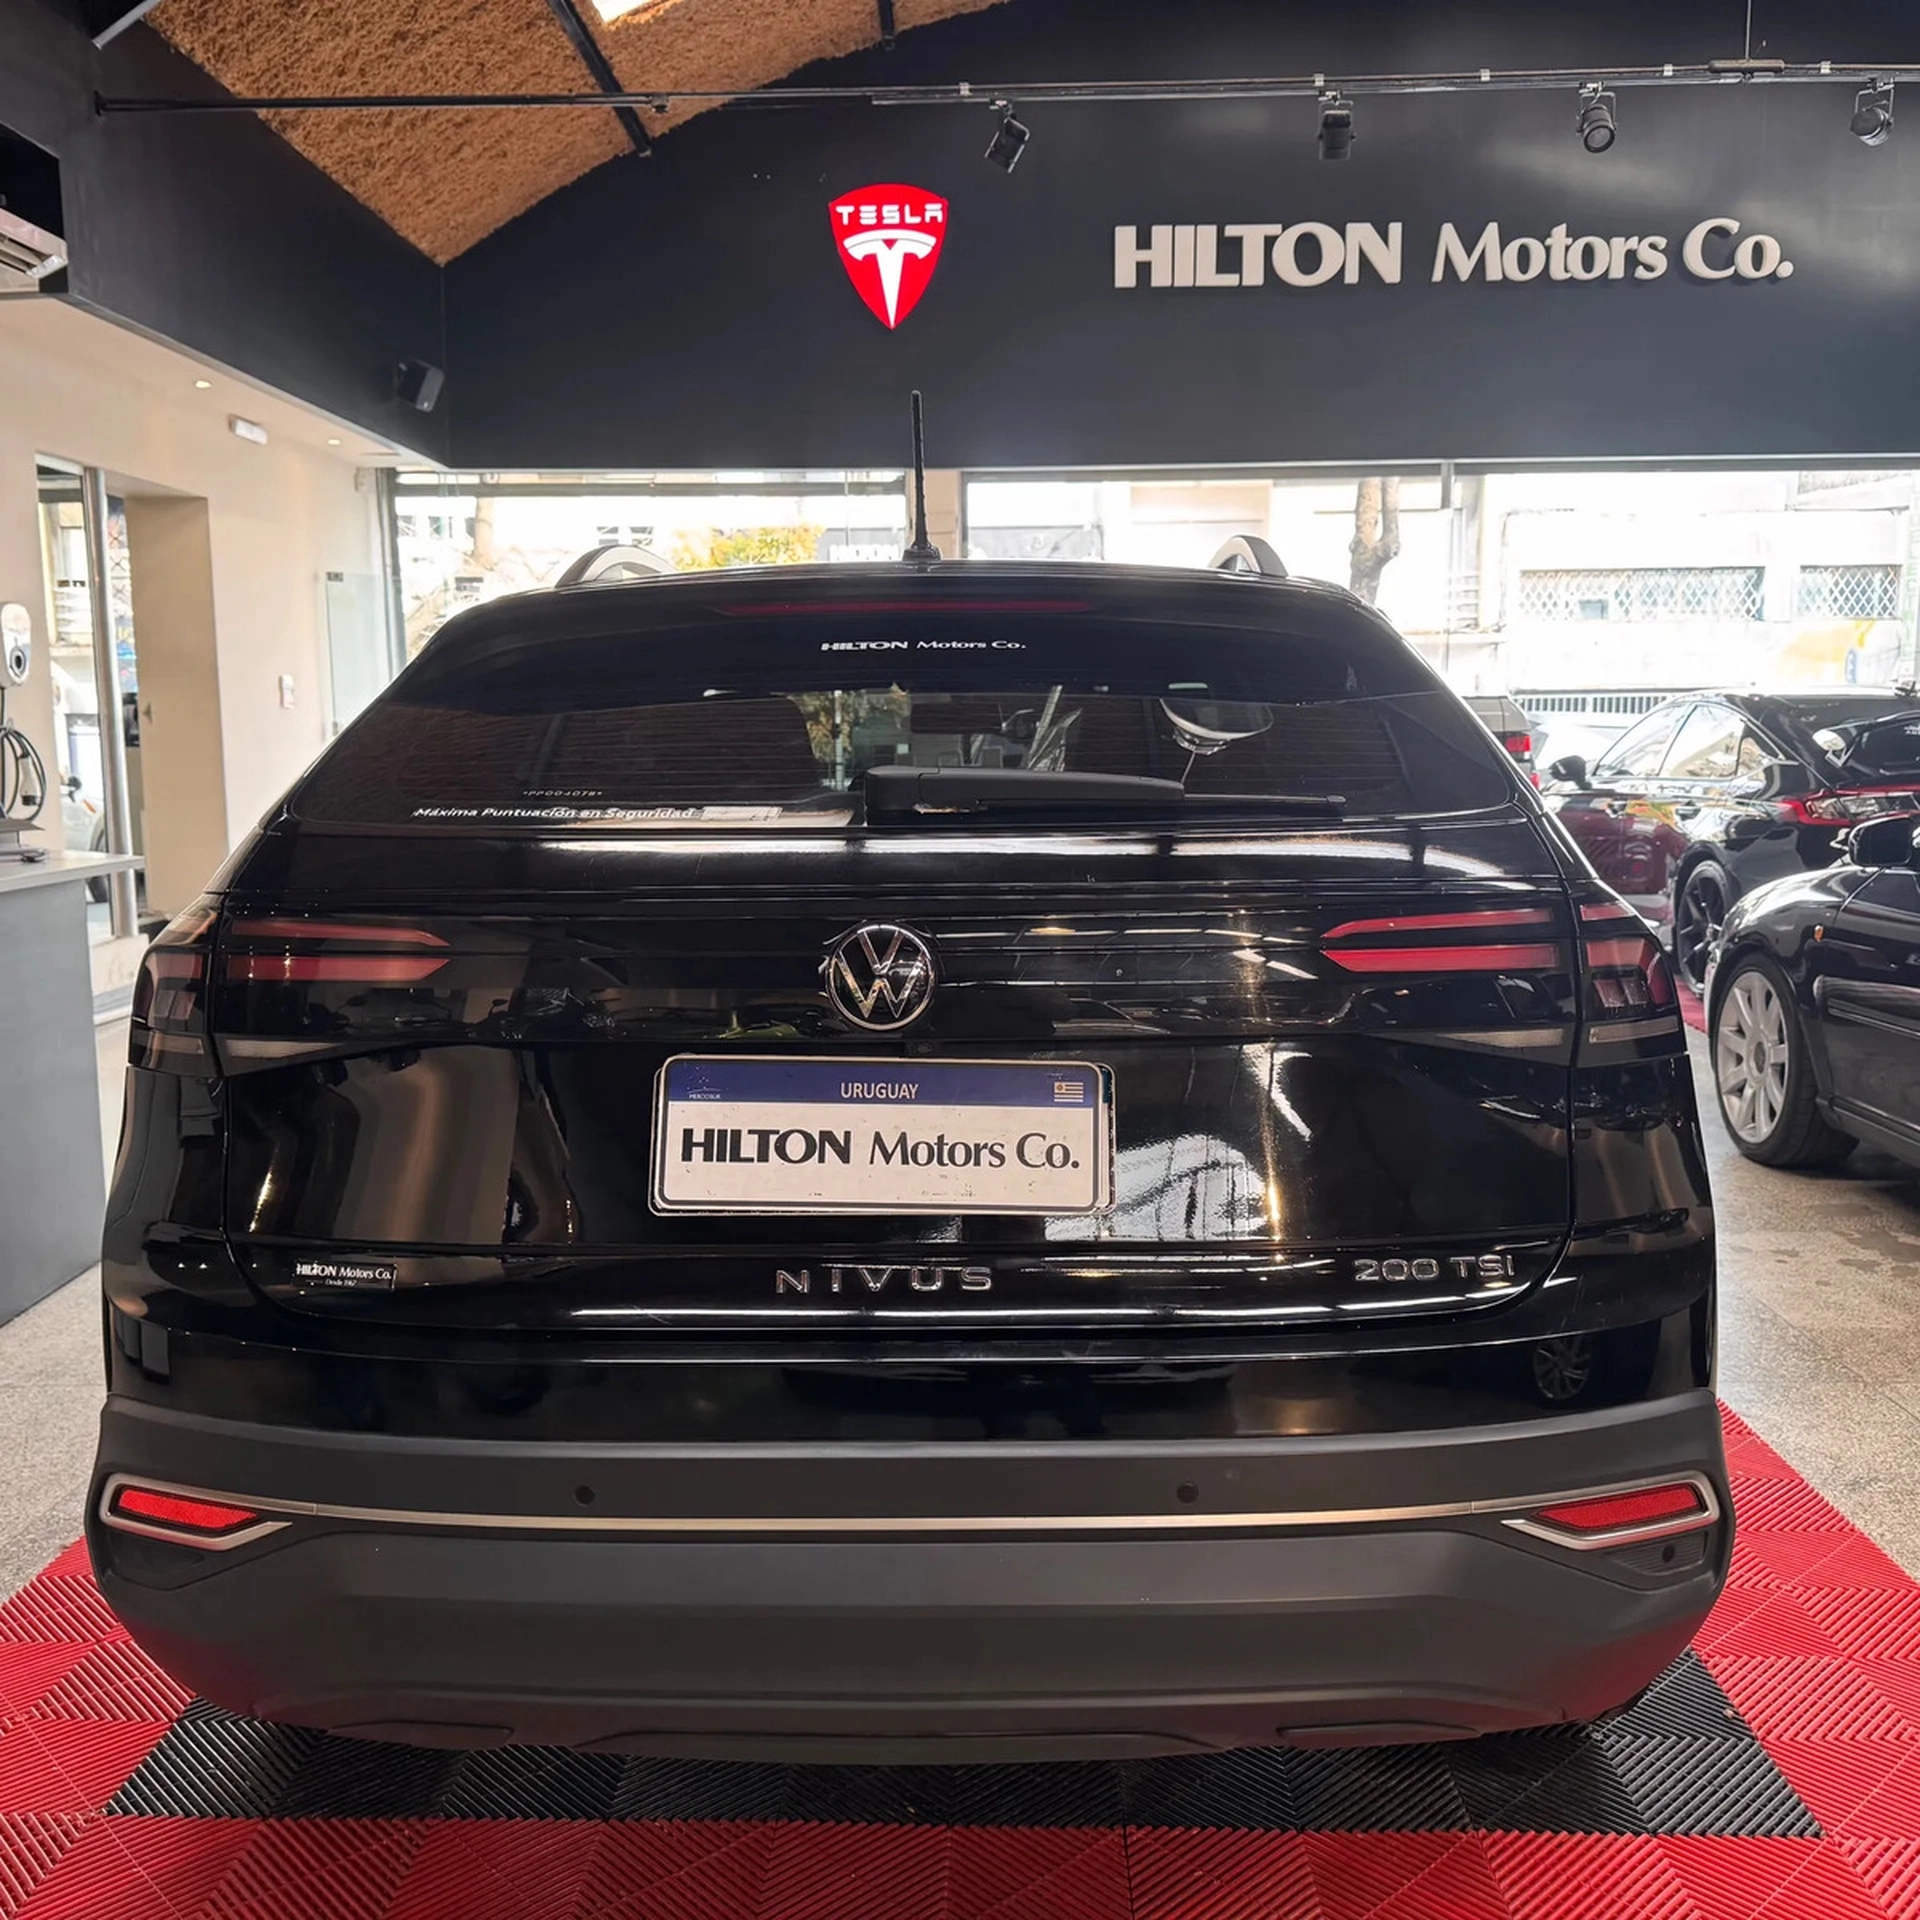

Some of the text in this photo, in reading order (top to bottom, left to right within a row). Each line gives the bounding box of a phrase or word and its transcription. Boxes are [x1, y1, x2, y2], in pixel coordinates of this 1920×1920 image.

[836, 203, 943, 226] TESLA
[1114, 217, 1795, 288] HILTON Motors Co.
[821, 640, 1027, 651] HILTON Motors Co.
[411, 805, 695, 821] Máxima Puntuación en Seguridad
[840, 1082, 919, 1100] URUGUAY
[681, 1128, 1080, 1169] HILTON Motors Co.
[296, 1263, 336, 1276] HILTON
[339, 1267, 374, 1279] Motors
[1354, 1254, 1515, 1281] 200 TSI
[776, 1266, 992, 1294] NIVUS
